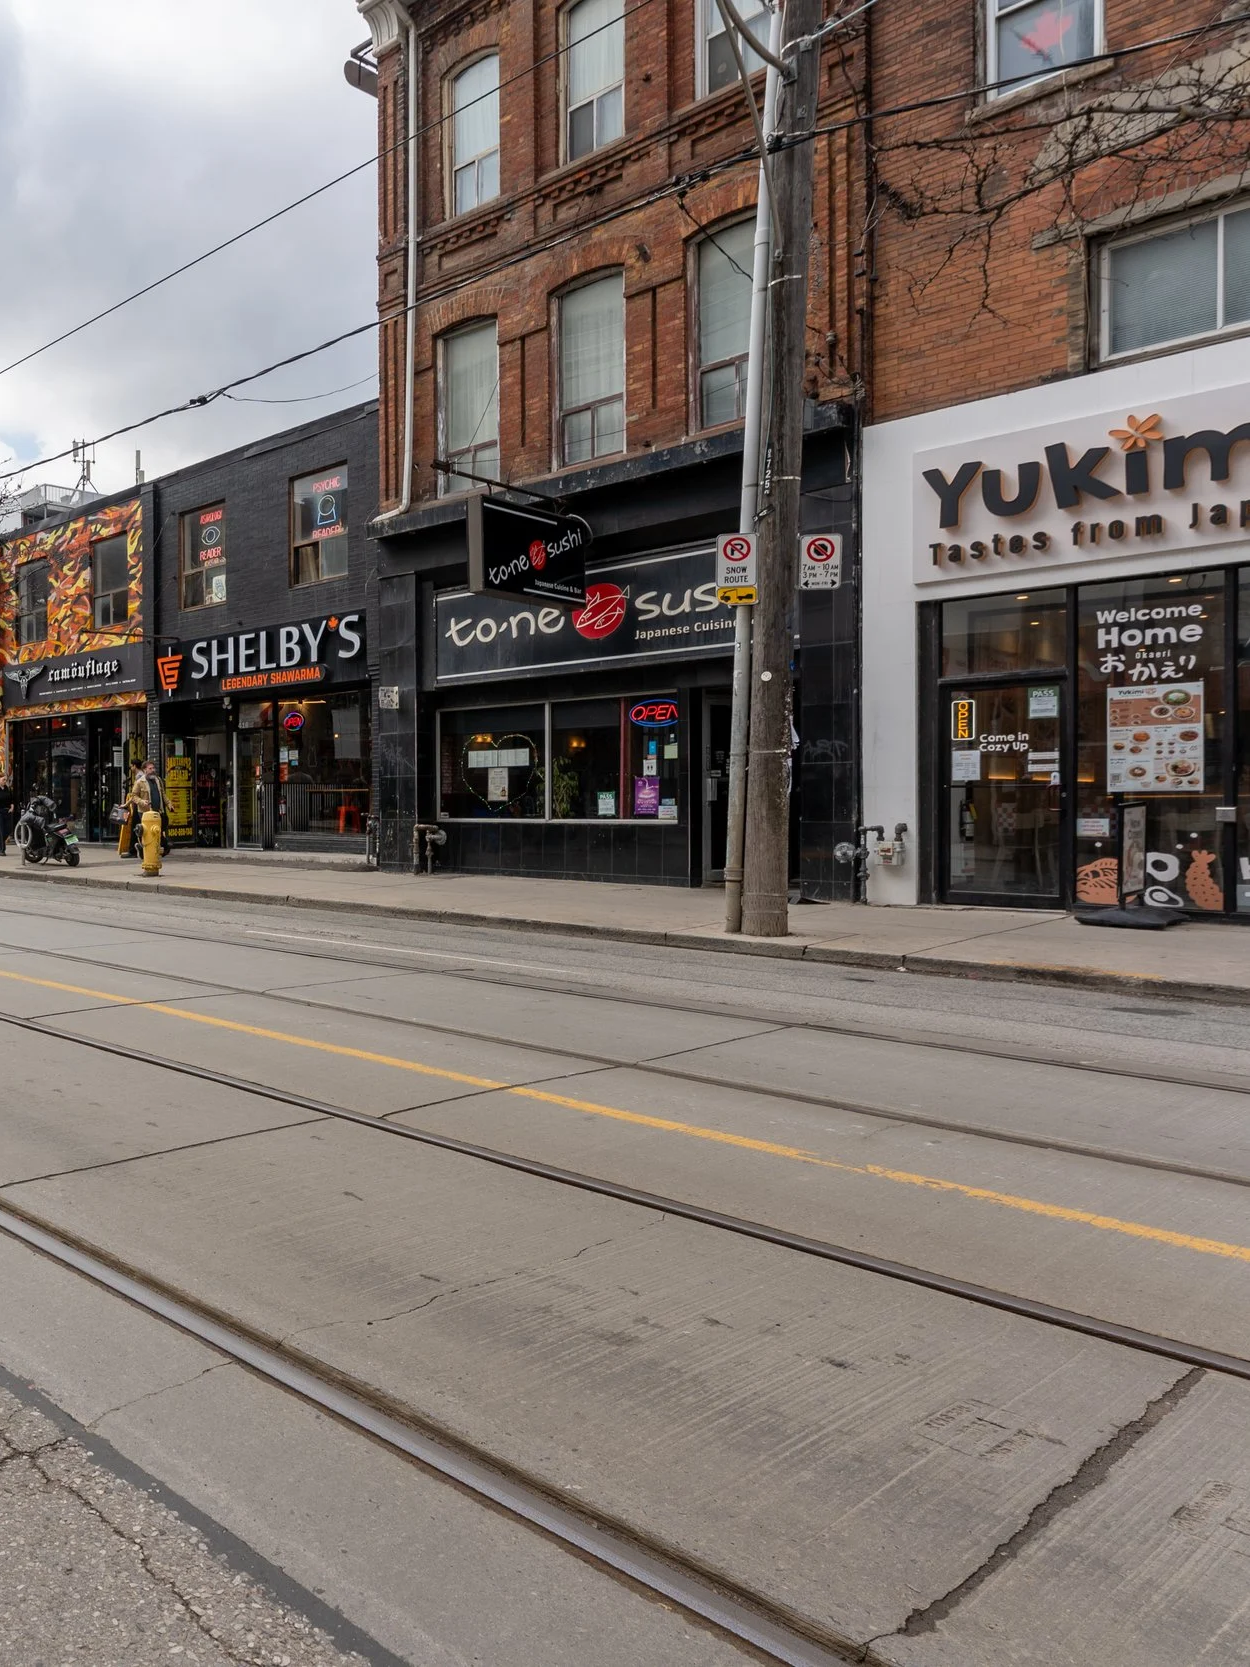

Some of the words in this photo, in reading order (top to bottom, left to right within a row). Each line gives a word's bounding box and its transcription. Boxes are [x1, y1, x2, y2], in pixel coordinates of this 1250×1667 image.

[312, 476, 340, 492] PSYCHIC
[312, 526, 341, 538] READER
[929, 531, 1050, 566] Tastes
[1070, 513, 1163, 546] from
[547, 528, 583, 558] sushi
[200, 546, 222, 561] READER
[726, 566, 748, 575] SNOW
[534, 579, 554, 589] Japanese
[554, 583, 569, 593] Cuisine
[574, 586, 582, 594] Bar
[724, 575, 749, 584] ROUTE
[1096, 604, 1203, 624] Welcome
[634, 626, 690, 640] Japanese
[694, 620, 736, 632] Cuisin
[1098, 624, 1204, 649] Home
[1100, 654, 1197, 682] おかえり
[222, 672, 268, 691] LEGENDARY
[270, 666, 320, 685] SHAWARMA
[1032, 689, 1054, 697] PASS
[285, 716, 303, 727] OPEN
[958, 702, 969, 738] OPEN
[979, 734, 1016, 743] Come
[1017, 732, 1029, 741] in
[979, 743, 1010, 753] Cozy
[1012, 742, 1029, 752] Up
